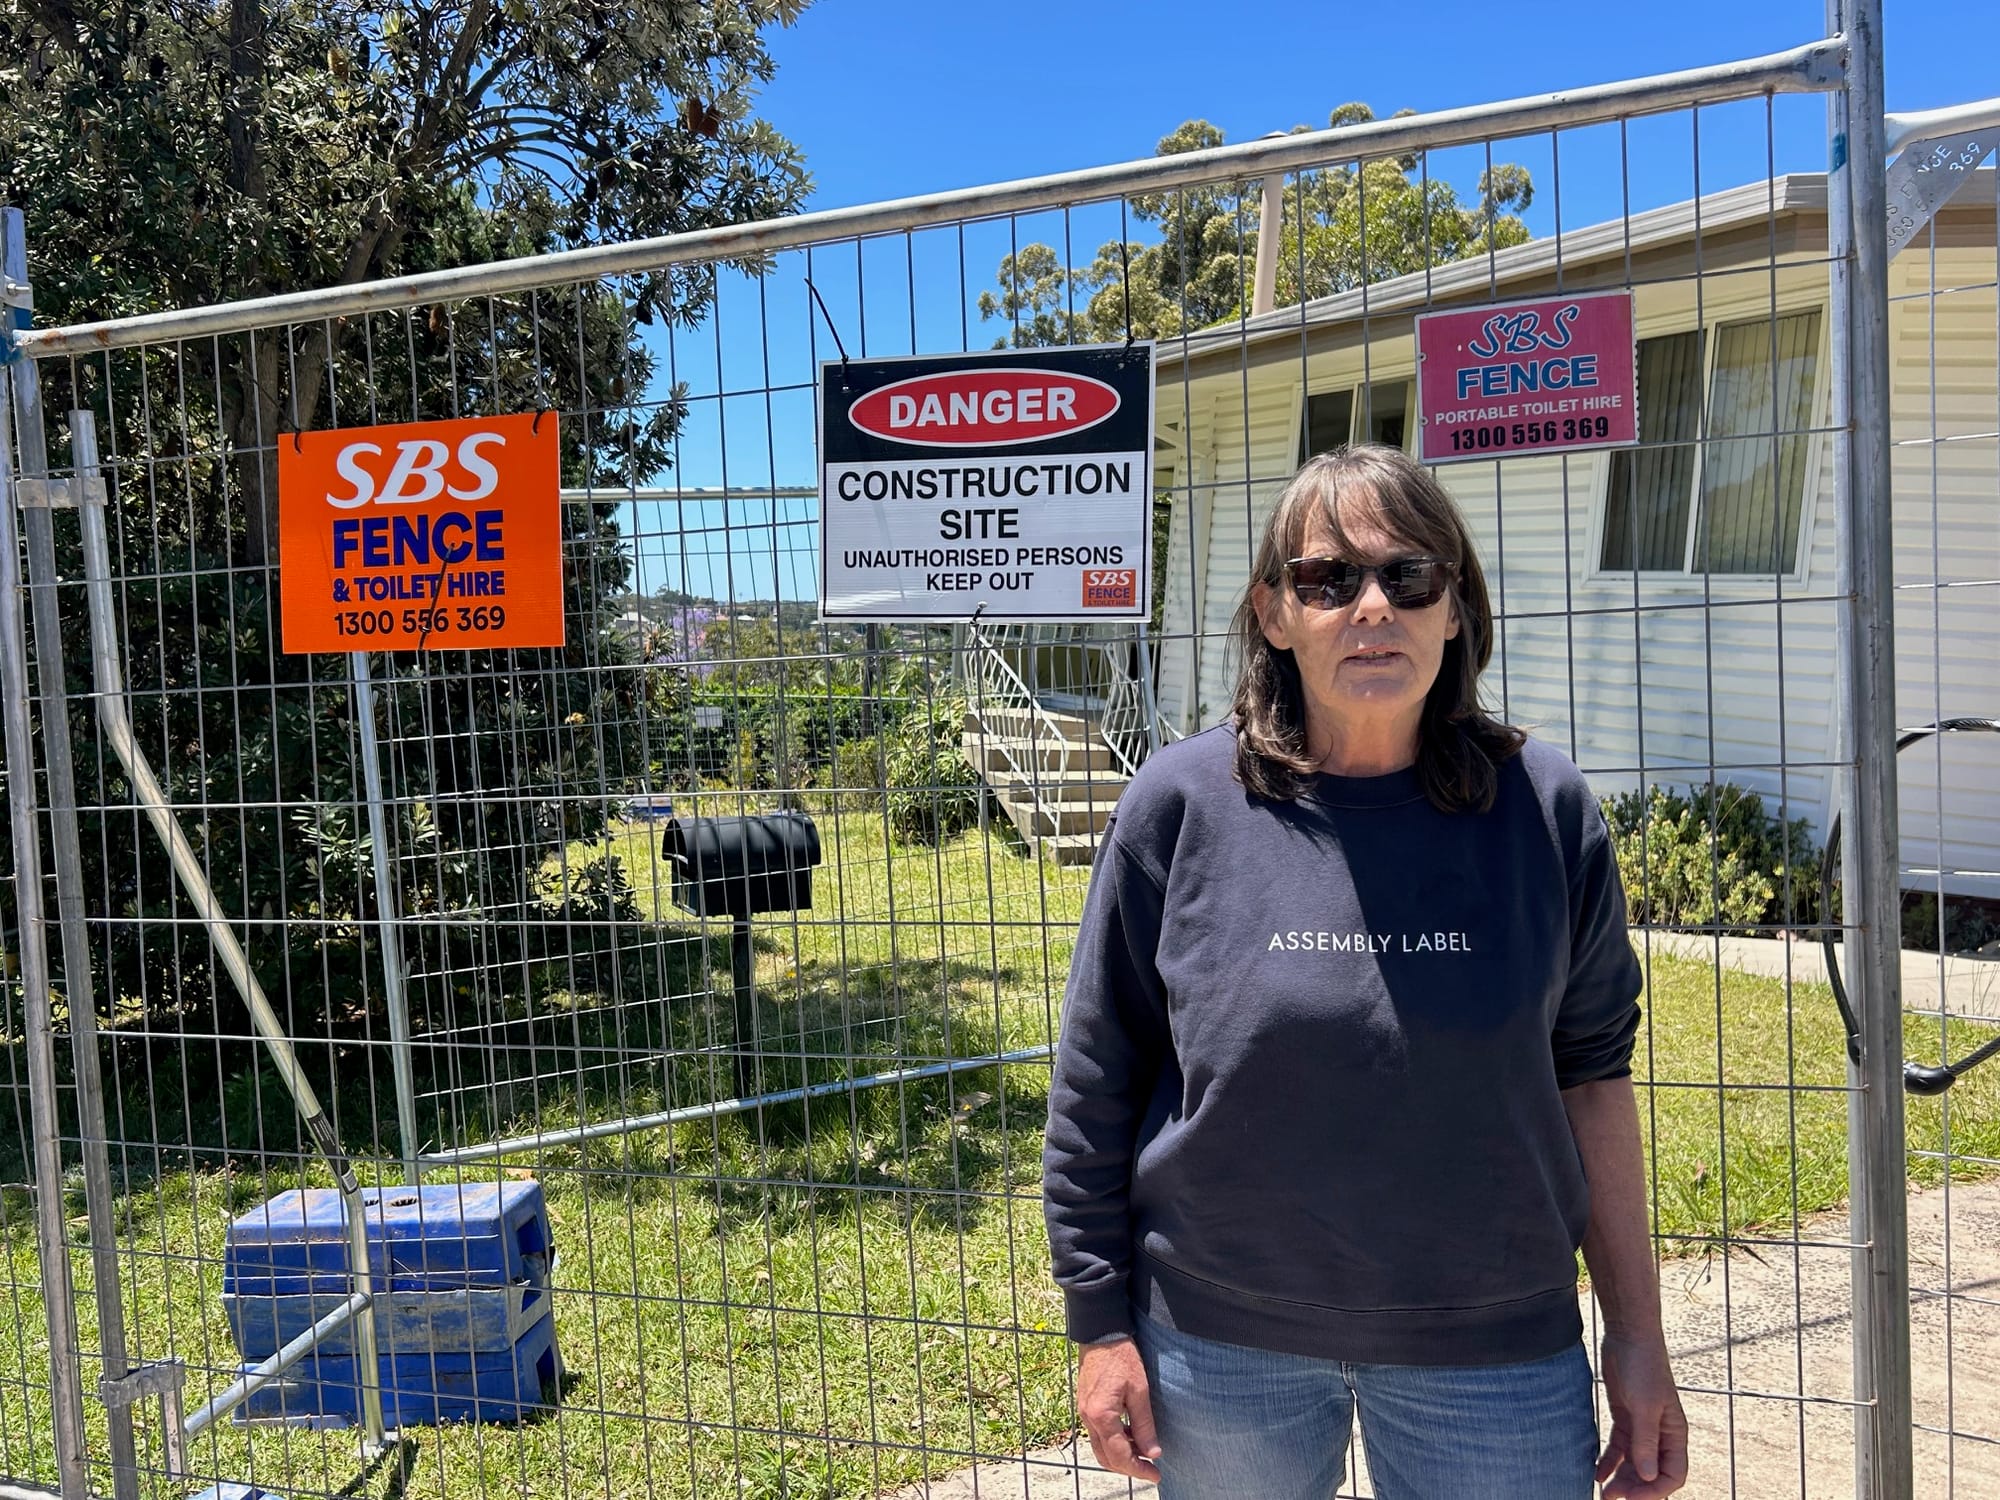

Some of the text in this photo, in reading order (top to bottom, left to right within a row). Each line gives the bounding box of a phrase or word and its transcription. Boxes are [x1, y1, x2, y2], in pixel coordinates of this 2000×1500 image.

[1468, 304, 1581, 358] SBS
[1457, 354, 1598, 400] FENCE
[889, 386, 1078, 429] DANGER
[1435, 395, 1622, 425] PORTABLE TOILET HIRE
[1450, 416, 1609, 451] 1300 556 369
[326, 432, 506, 509] SBS
[838, 462, 1131, 502] CONSTRUCTION
[332, 509, 505, 569] FENCE
[940, 508, 1020, 540] SITE
[844, 545, 1124, 569] UNAUTHORISED PERSONS
[332, 570, 506, 603] & TOILET HIRE
[926, 571, 1034, 592] KEEP OUT
[1087, 571, 1132, 586] SBS
[1088, 587, 1130, 599] FENCE
[334, 606, 506, 636] 1300 556 369
[1267, 931, 1471, 953] ASSEMBLY LABEL
